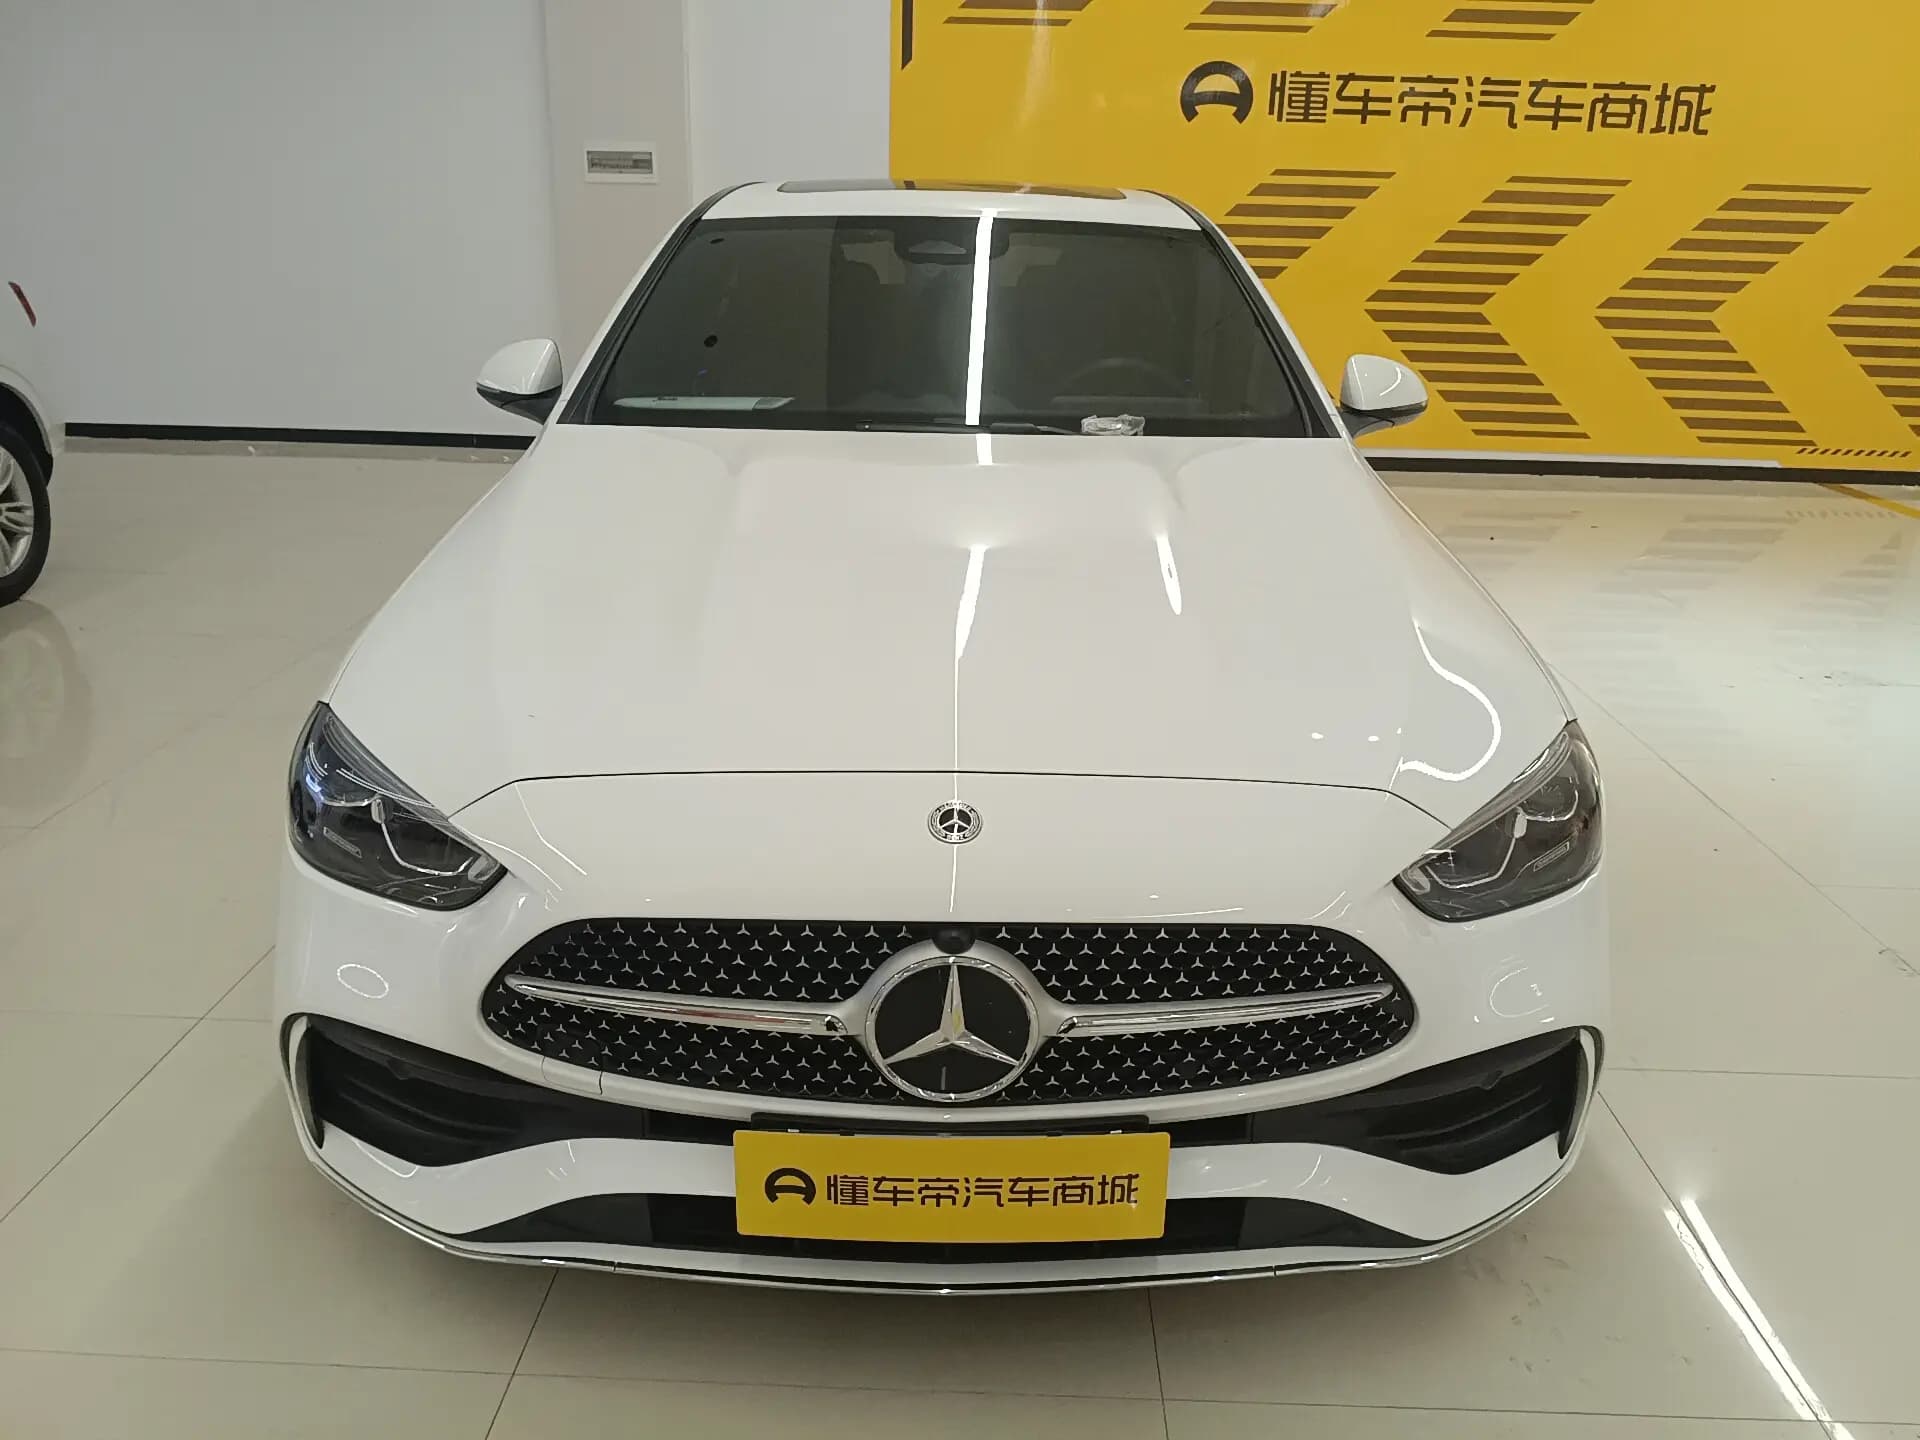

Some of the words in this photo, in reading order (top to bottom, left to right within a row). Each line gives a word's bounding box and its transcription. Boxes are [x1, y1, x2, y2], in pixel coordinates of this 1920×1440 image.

[1268, 70, 1716, 136] 懂车帝汽车商城
[826, 1173, 1140, 1208] 懂车帝汽车商城
